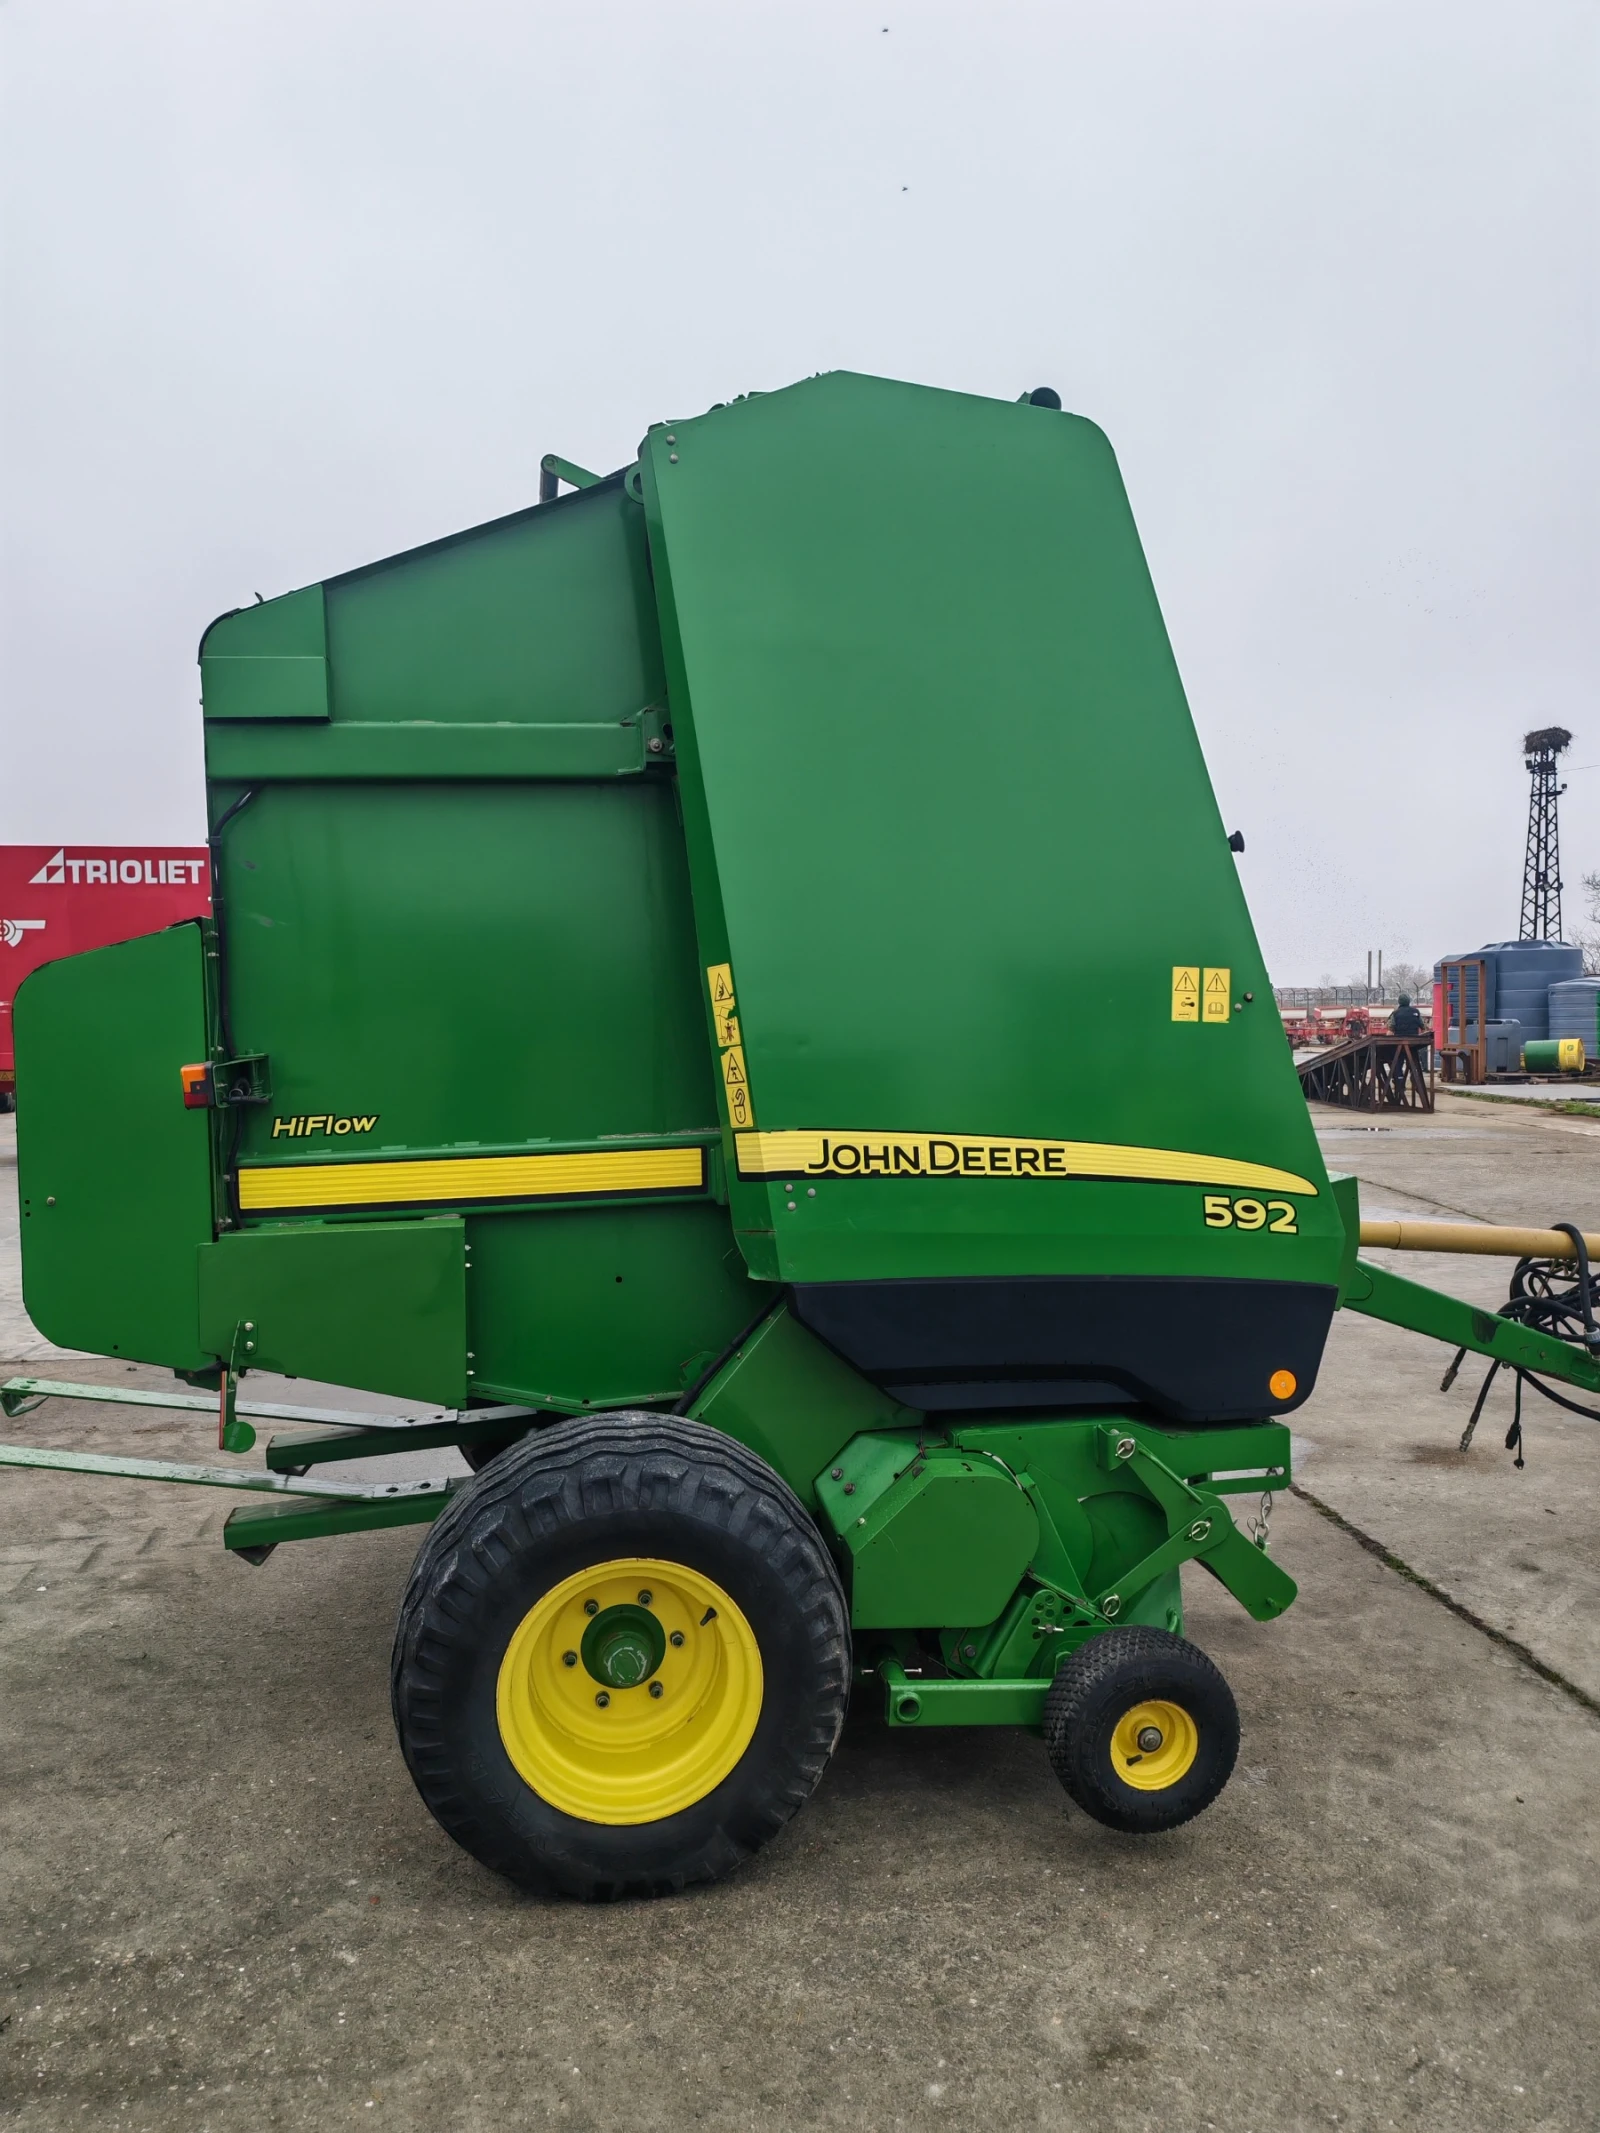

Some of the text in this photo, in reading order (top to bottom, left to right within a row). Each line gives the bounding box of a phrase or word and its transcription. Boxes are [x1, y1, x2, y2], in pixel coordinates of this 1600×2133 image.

[66, 859, 205, 885] TRIOLIET
[272, 1115, 379, 1138] HiFlow
[808, 1138, 1067, 1173] JOHN DEERE
[1204, 1195, 1298, 1234] 592
